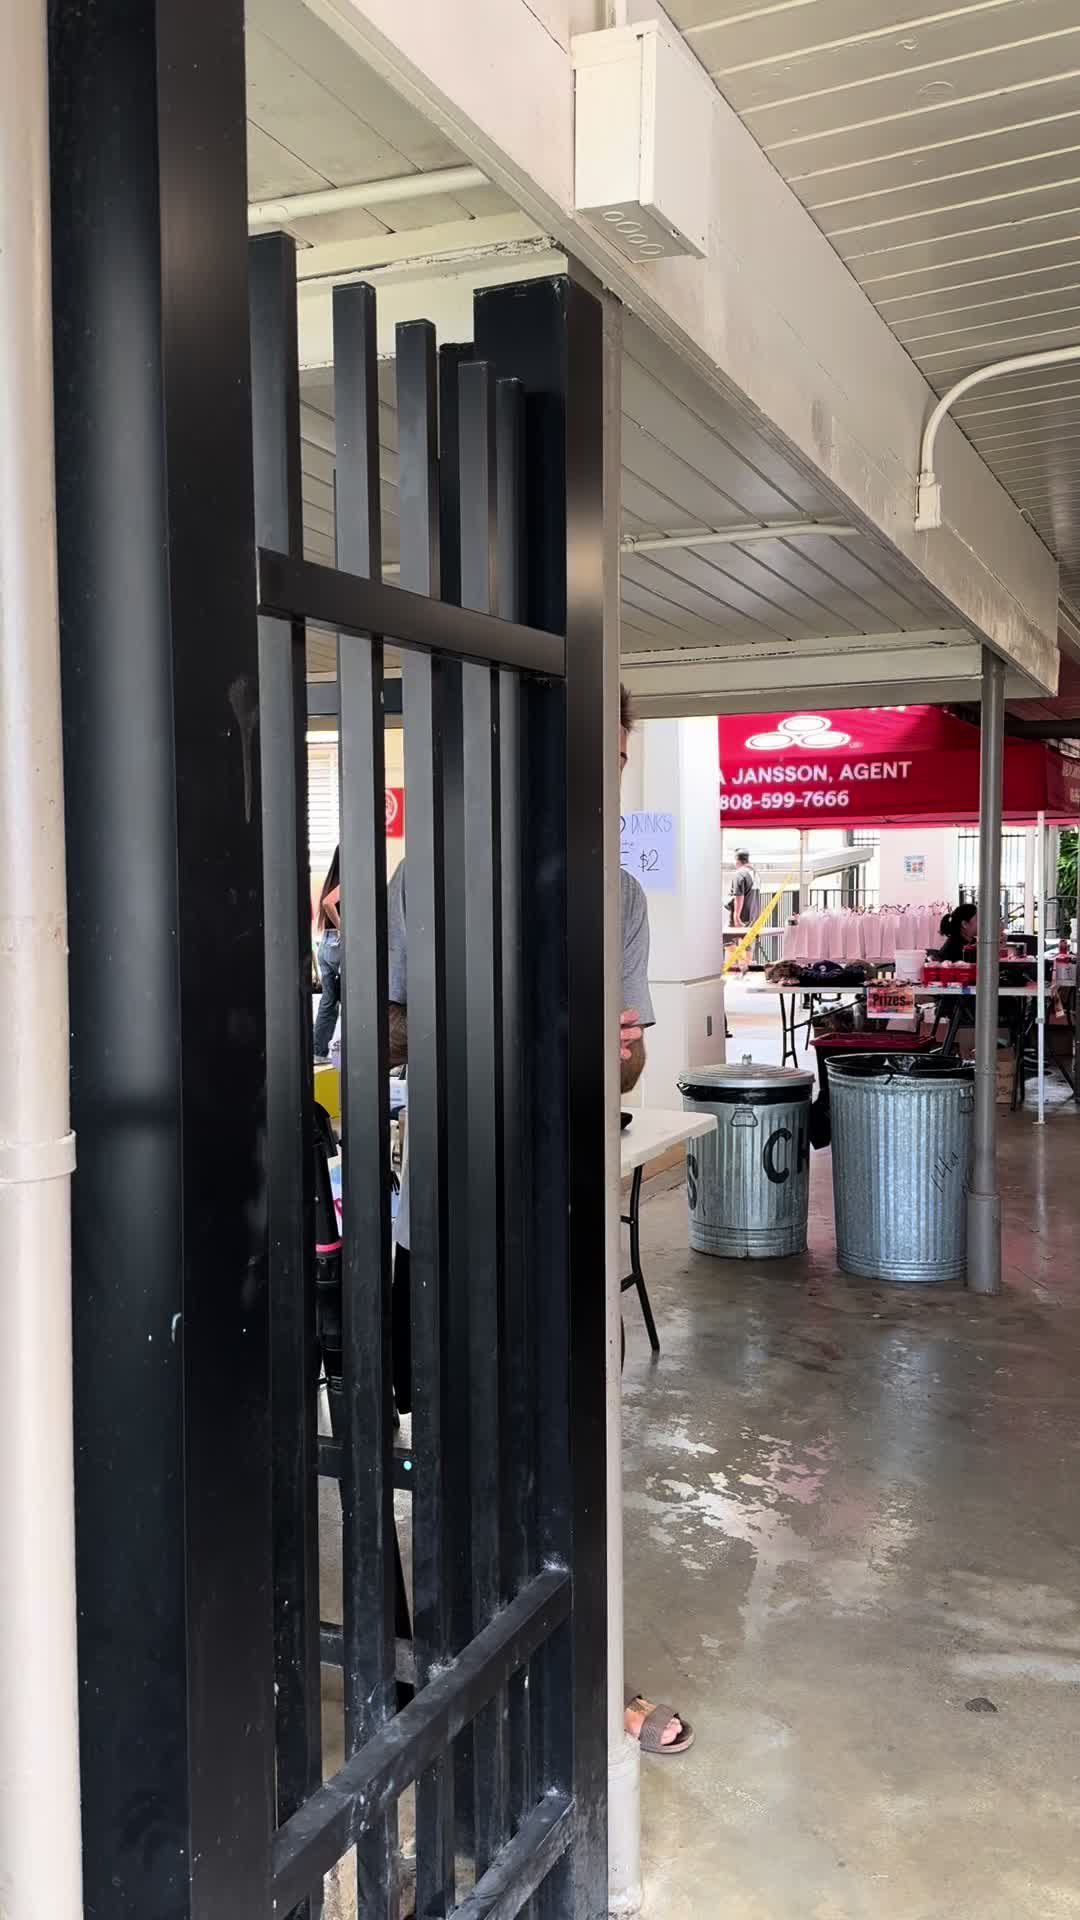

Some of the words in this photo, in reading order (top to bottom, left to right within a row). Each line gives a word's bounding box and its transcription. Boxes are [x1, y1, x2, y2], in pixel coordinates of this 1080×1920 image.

[731, 764, 834, 785] JANSSON,
[839, 761, 913, 781] AGENT
[719, 790, 849, 811] 808-599-7666
[639, 848, 661, 873] $2
[872, 992, 907, 1008] Prizes
